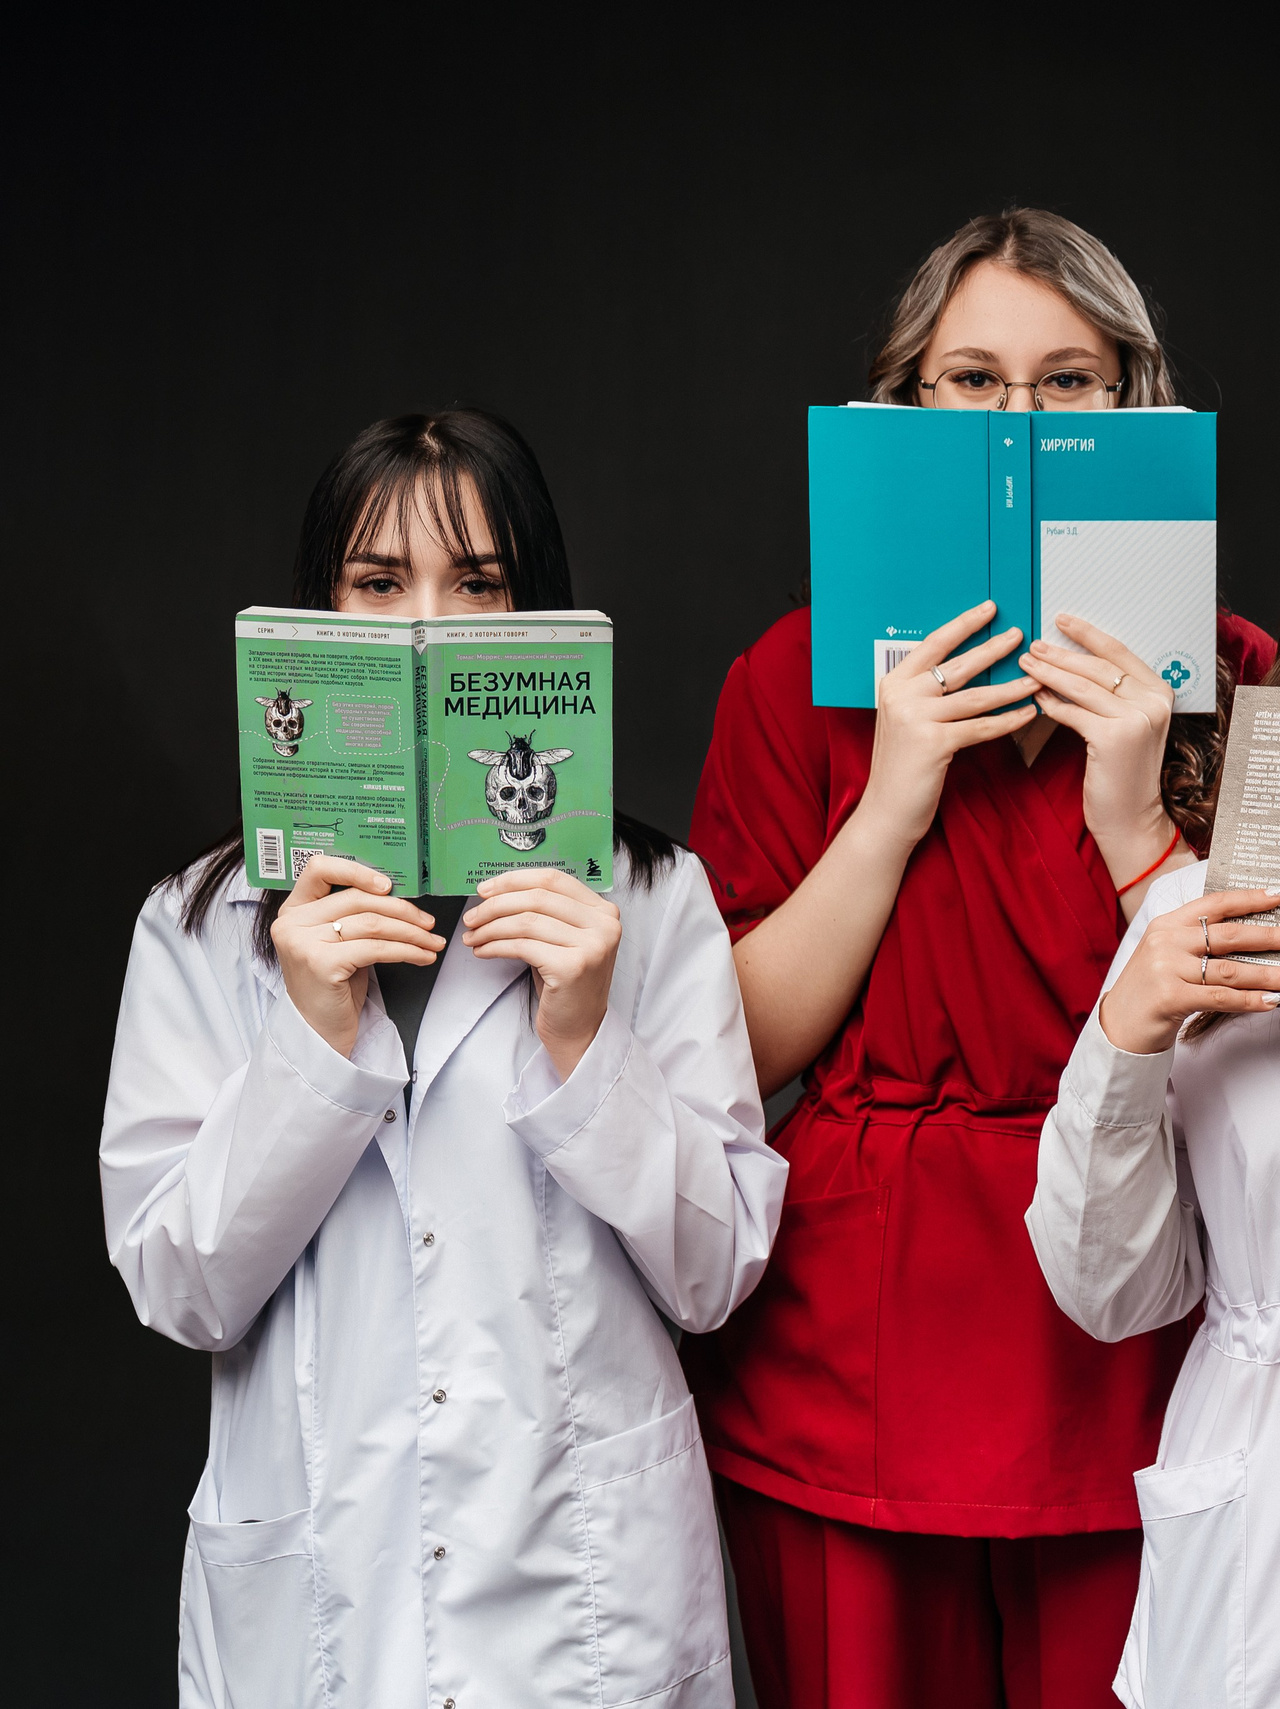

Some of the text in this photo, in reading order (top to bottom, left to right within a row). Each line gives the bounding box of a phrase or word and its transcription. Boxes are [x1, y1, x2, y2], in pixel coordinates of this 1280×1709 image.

[1040, 438, 1095, 452] ХИРУРГИЯ
[1005, 475, 1013, 508] ХИРУРГИЯ
[1046, 527, 1065, 536] Рубан
[450, 671, 591, 692] БЕЗУМНАЯ
[444, 695, 596, 720] МЕДИЦИНА
